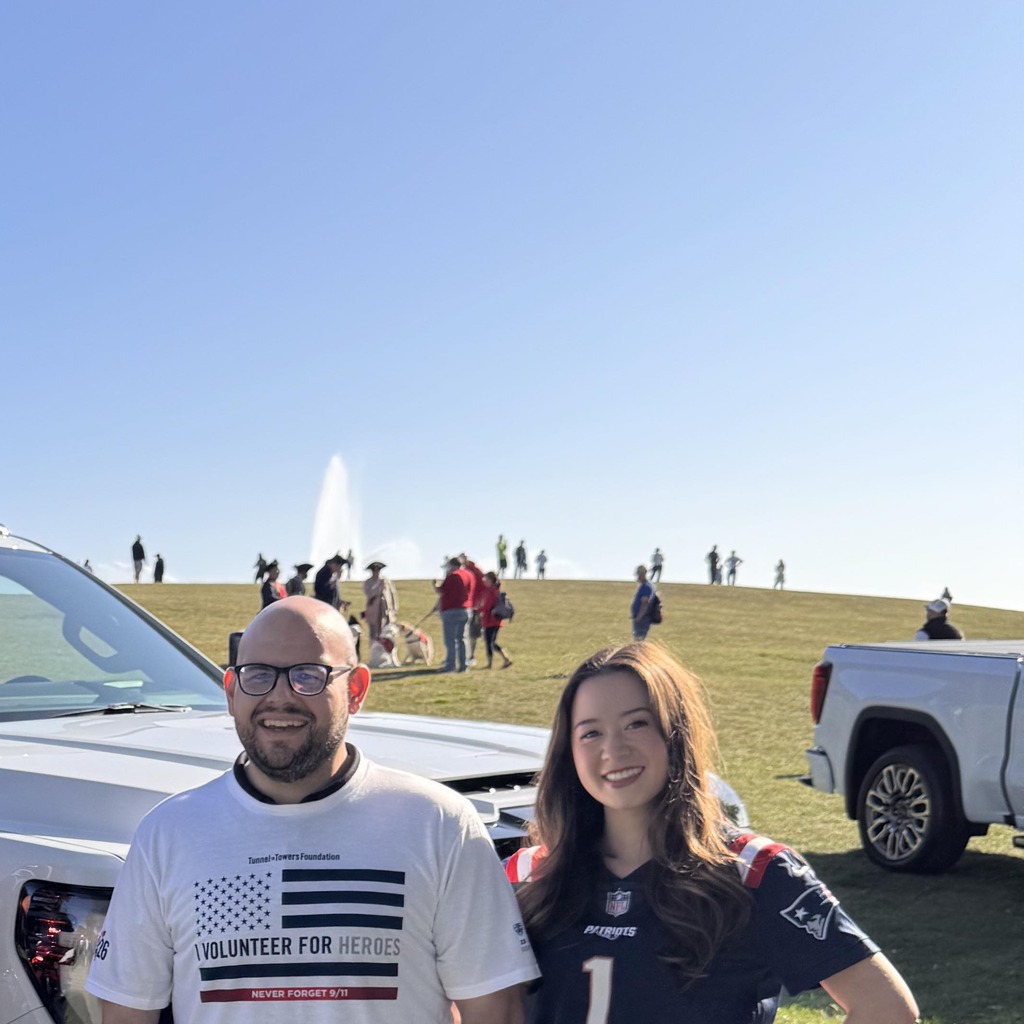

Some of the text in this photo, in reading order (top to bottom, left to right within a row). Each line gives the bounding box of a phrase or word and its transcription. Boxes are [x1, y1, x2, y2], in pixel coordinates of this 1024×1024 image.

[300, 853, 340, 861] Foundation
[583, 925, 637, 937] PATRIOTS
[202, 937, 292, 960] VOLUNTEER
[298, 936, 332, 955] FOR
[338, 936, 401, 956] HEROES
[251, 988, 348, 999] NEVER FORGET 9/11
